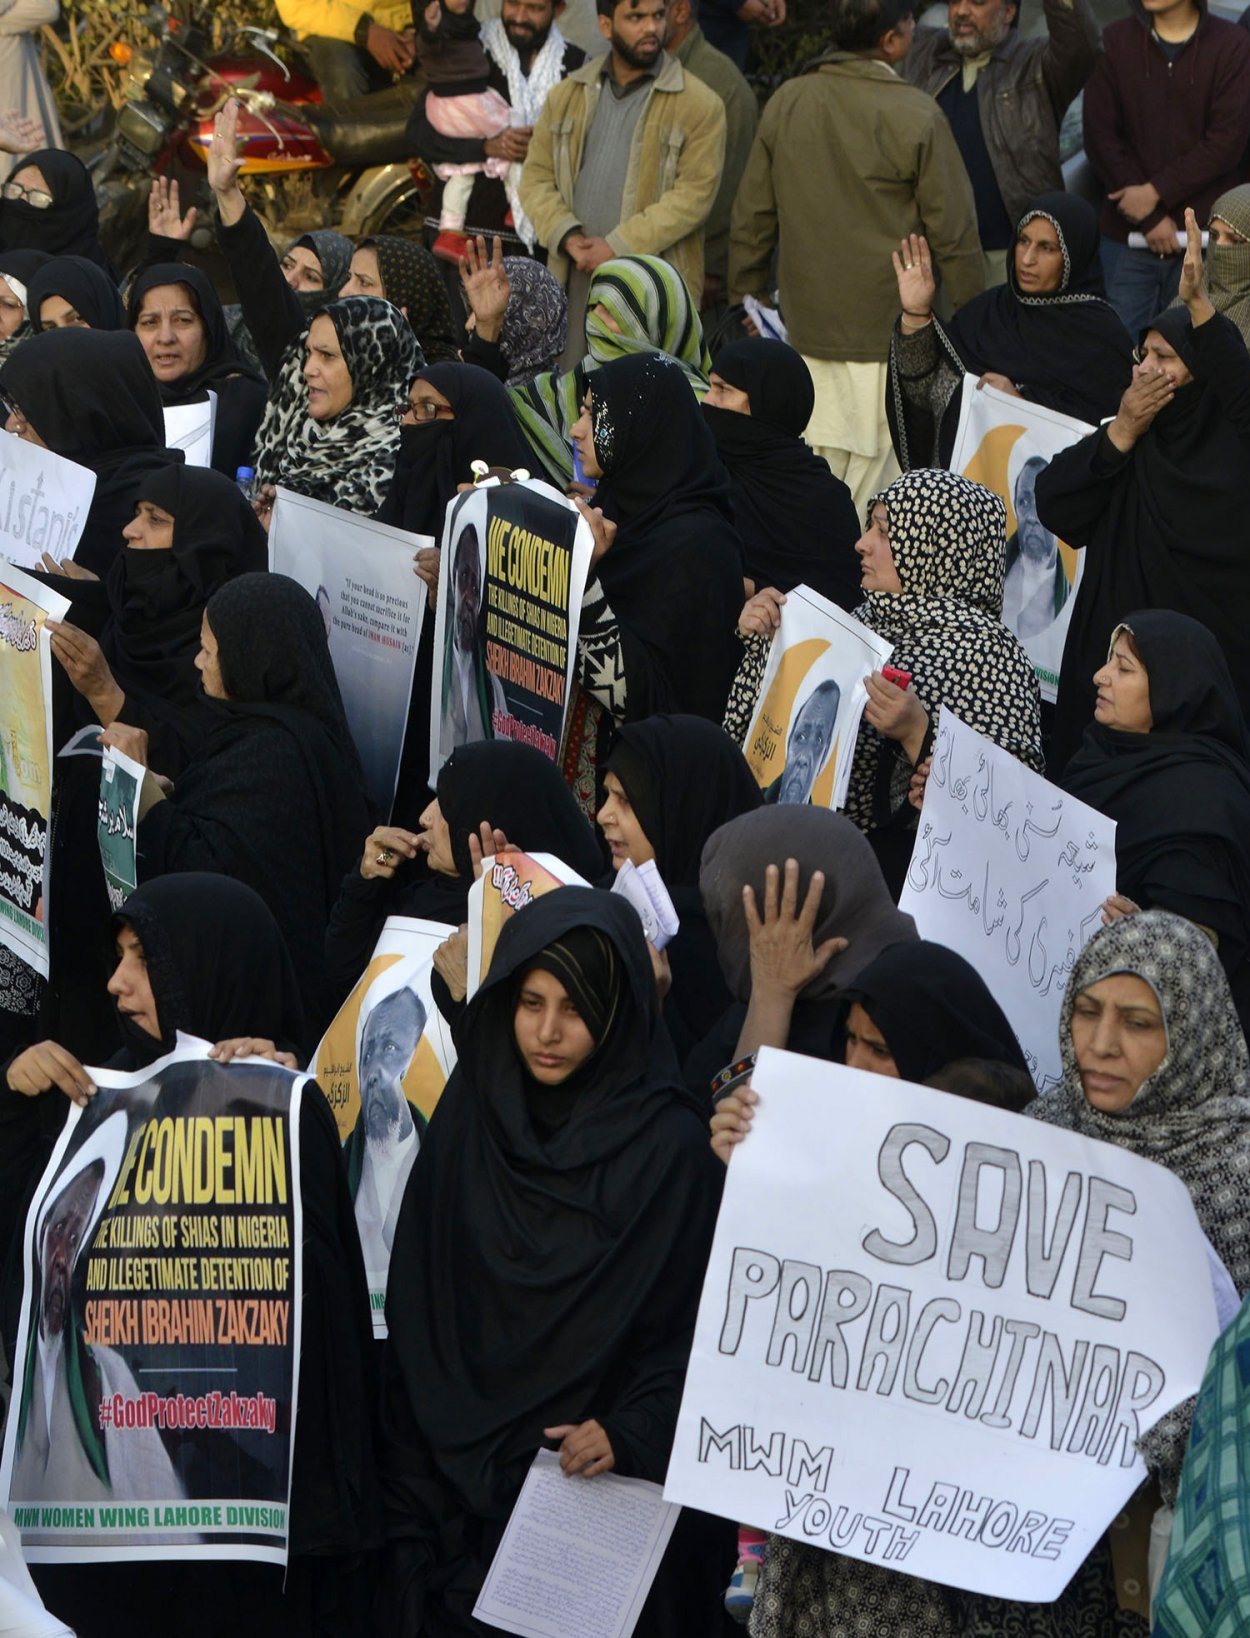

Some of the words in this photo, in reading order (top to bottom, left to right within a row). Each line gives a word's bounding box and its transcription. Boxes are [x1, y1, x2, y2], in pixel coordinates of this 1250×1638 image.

[488, 515, 512, 582] WE
[509, 525, 570, 611] CONDEMN
[360, 599, 376, 612] cannot
[376, 603, 397, 619] sacrifice
[369, 618, 390, 633] compare
[396, 626, 408, 638] with
[386, 594, 409, 609] precious
[488, 583, 498, 606] THE
[498, 586, 519, 617] KILLINGS
[519, 596, 526, 621] OF
[526, 600, 541, 629] SHIAS
[541, 606, 547, 633] IN
[547, 609, 568, 642] NIGERIA
[487, 611, 498, 637] AND
[532, 632, 560, 668] DETENTION
[559, 644, 567, 670] OF
[486, 640, 510, 681] SHEIKH
[510, 650, 536, 695] IBRAHIM
[535, 662, 566, 708] ZAKZAKY
[134, 1116, 288, 1206] CONDEMN
[110, 1216, 160, 1249] KILLINGS
[162, 1216, 179, 1249] OF
[181, 1216, 220, 1250] SHIAS
[221, 1216, 236, 1249] IN
[238, 1216, 290, 1249] NIGERIA
[862, 1122, 1138, 1322] SAVE
[86, 1258, 109, 1292] AND
[109, 1258, 199, 1292] ILLEGETIMATE
[201, 1258, 273, 1292] DETENTION
[274, 1258, 290, 1292] OF
[84, 1300, 139, 1346] SHEIKH
[142, 1300, 215, 1346] IBRAHIM
[216, 1300, 290, 1346] ZAKZAKY
[718, 1247, 1166, 1468] PARACHINAR
[100, 1391, 276, 1434] #GodProtectZakzaky
[14, 1507, 40, 1528] MWM
[41, 1508, 95, 1528] WOMEN
[100, 1507, 150, 1529] WING
[154, 1506, 222, 1528] LAHORE
[226, 1506, 286, 1530] DIVISION
[698, 1416, 834, 1493] MWM
[882, 1467, 1076, 1561] LAHORE
[775, 1490, 921, 1561] YOUTH
